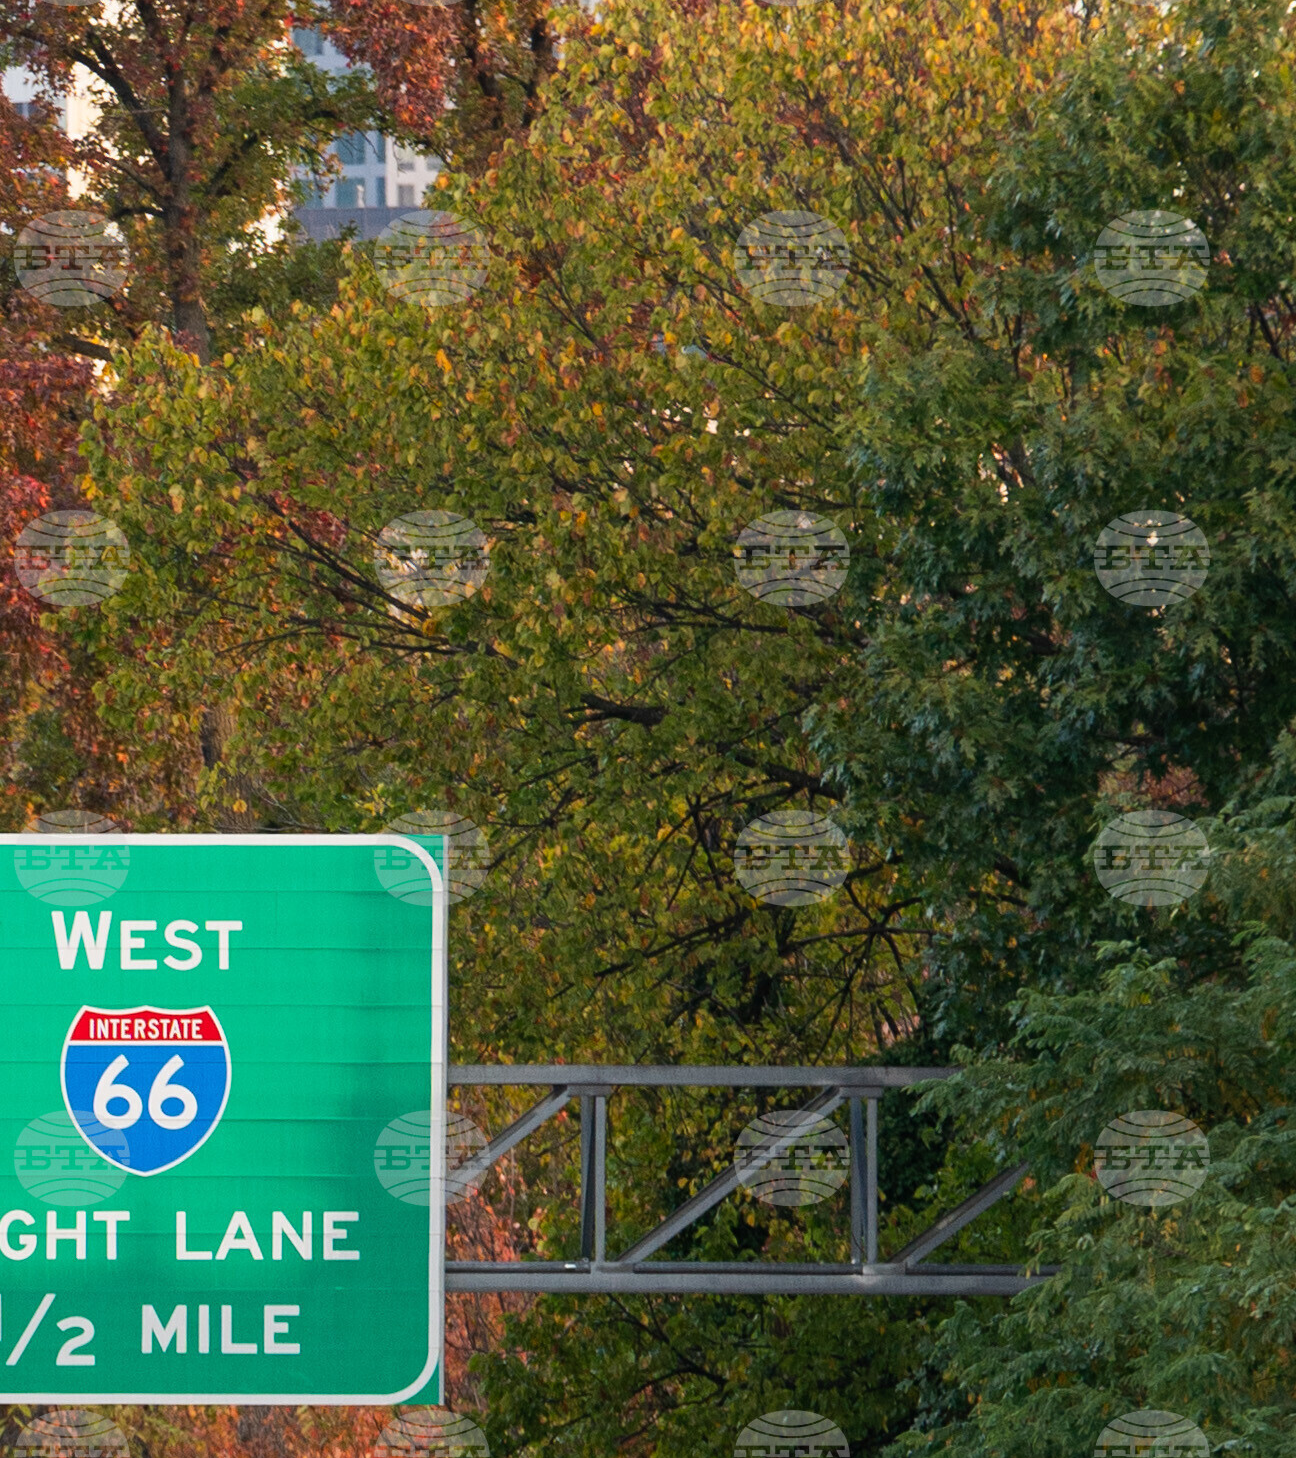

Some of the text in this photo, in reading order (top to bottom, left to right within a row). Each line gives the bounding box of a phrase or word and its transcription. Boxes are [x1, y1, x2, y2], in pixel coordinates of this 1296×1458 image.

[51, 910, 243, 970] WEST
[89, 1018, 203, 1041] INTERSTATE
[93, 1054, 198, 1130] 66
[176, 1211, 360, 1261] LANE
[142, 1305, 301, 1354] MILE
